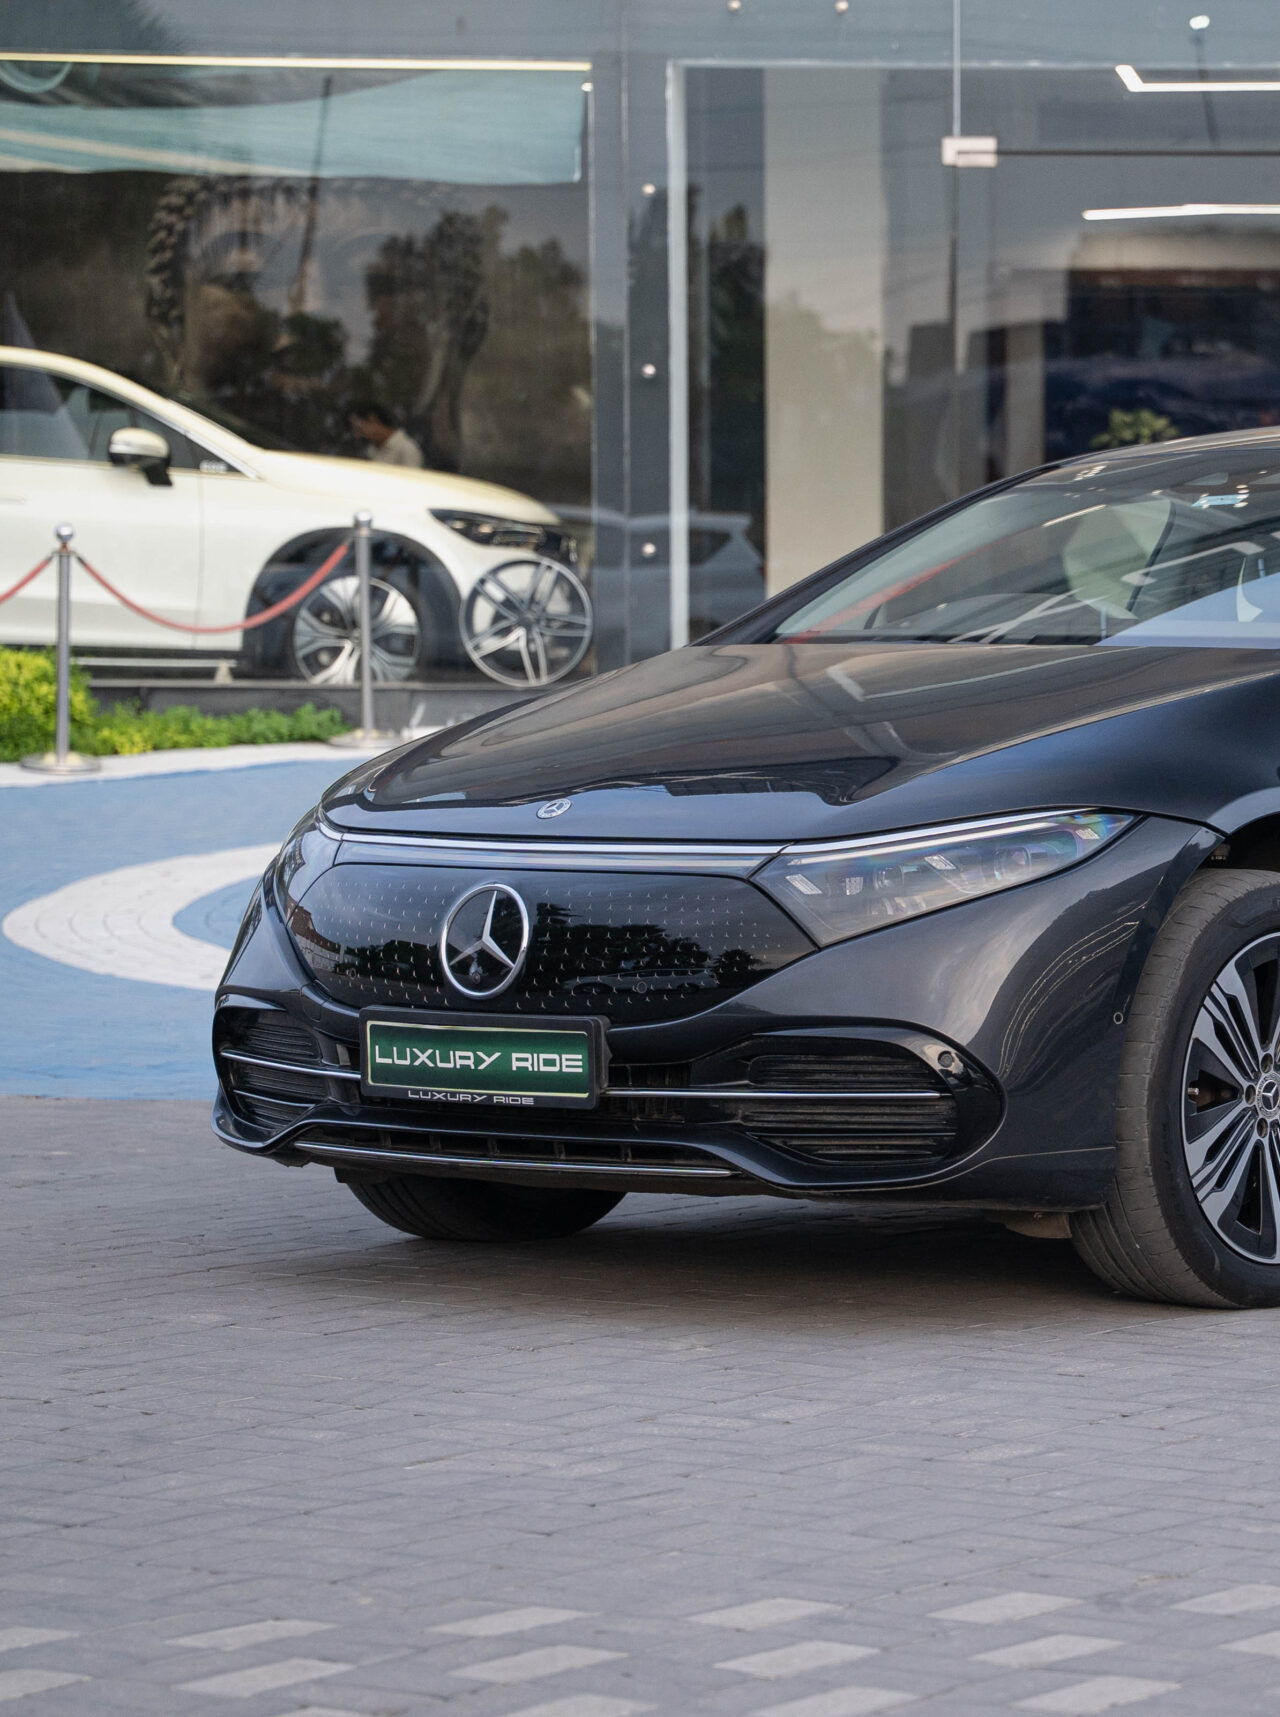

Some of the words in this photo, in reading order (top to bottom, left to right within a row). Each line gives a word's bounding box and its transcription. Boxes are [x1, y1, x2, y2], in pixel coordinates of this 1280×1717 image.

[375, 1045, 501, 1069] LUXURY
[511, 1052, 583, 1072] RIDE
[408, 1090, 487, 1102] LUXURY
[493, 1096, 534, 1105] RIDE
